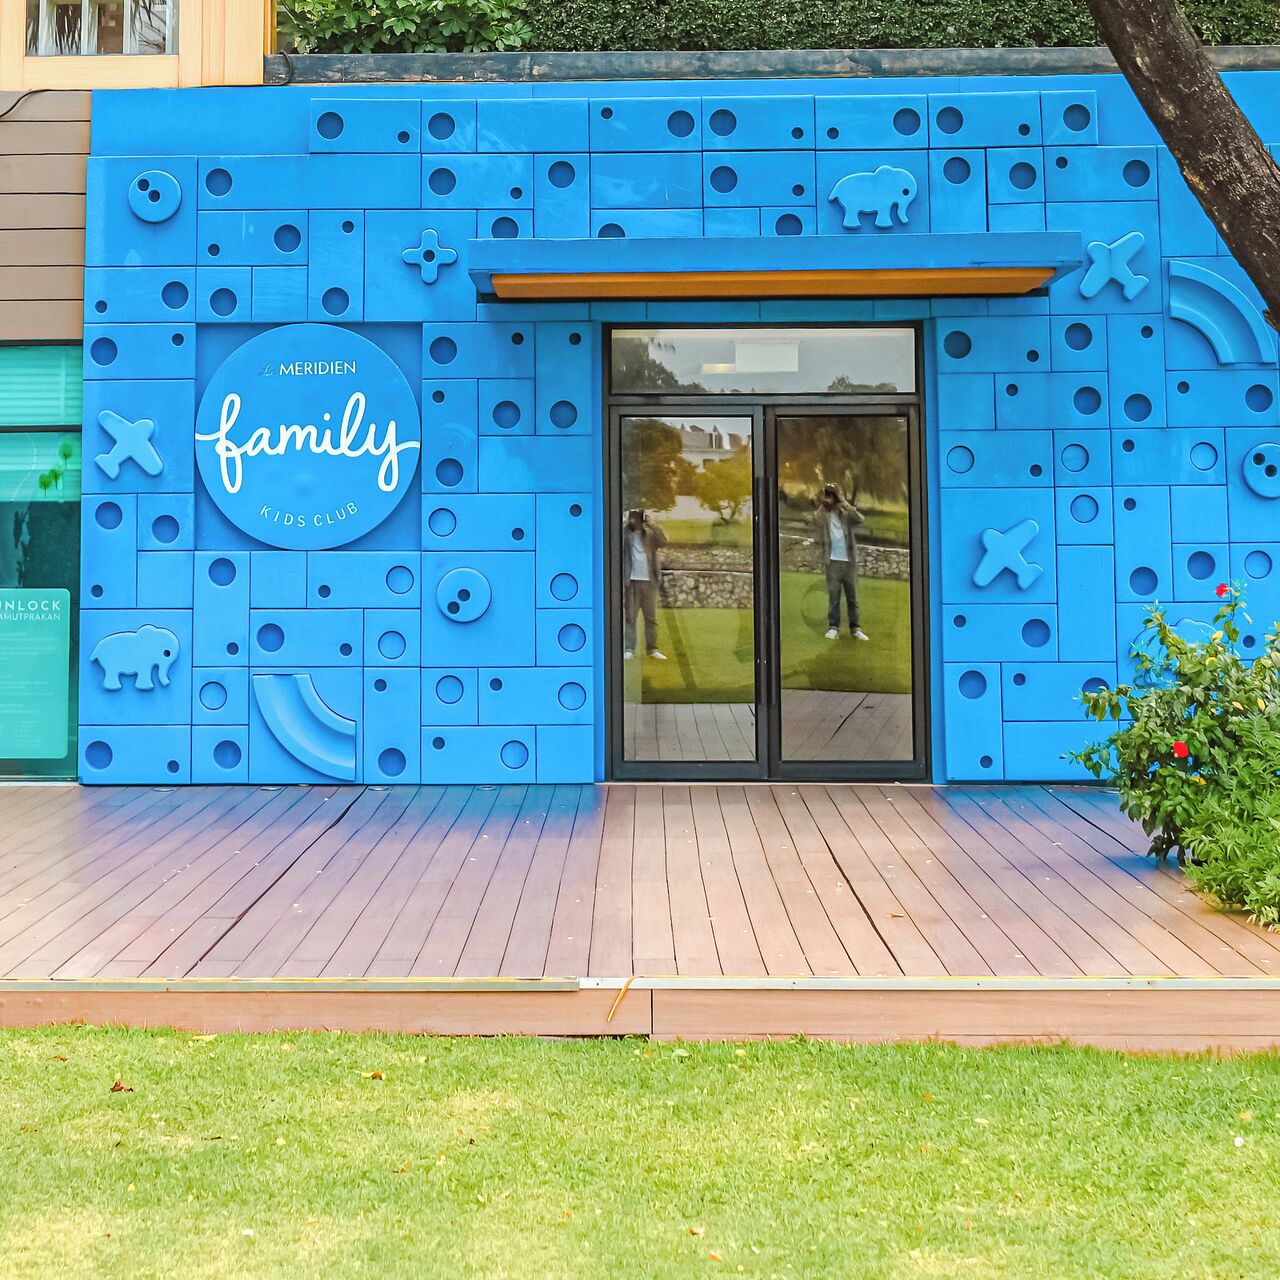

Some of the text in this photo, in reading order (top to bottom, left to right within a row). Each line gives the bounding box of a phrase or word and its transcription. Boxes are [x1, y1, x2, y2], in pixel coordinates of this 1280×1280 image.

[279, 360, 356, 376] MERIDIEN
[195, 392, 420, 494] family
[260, 502, 358, 527] KIDS CLUB
